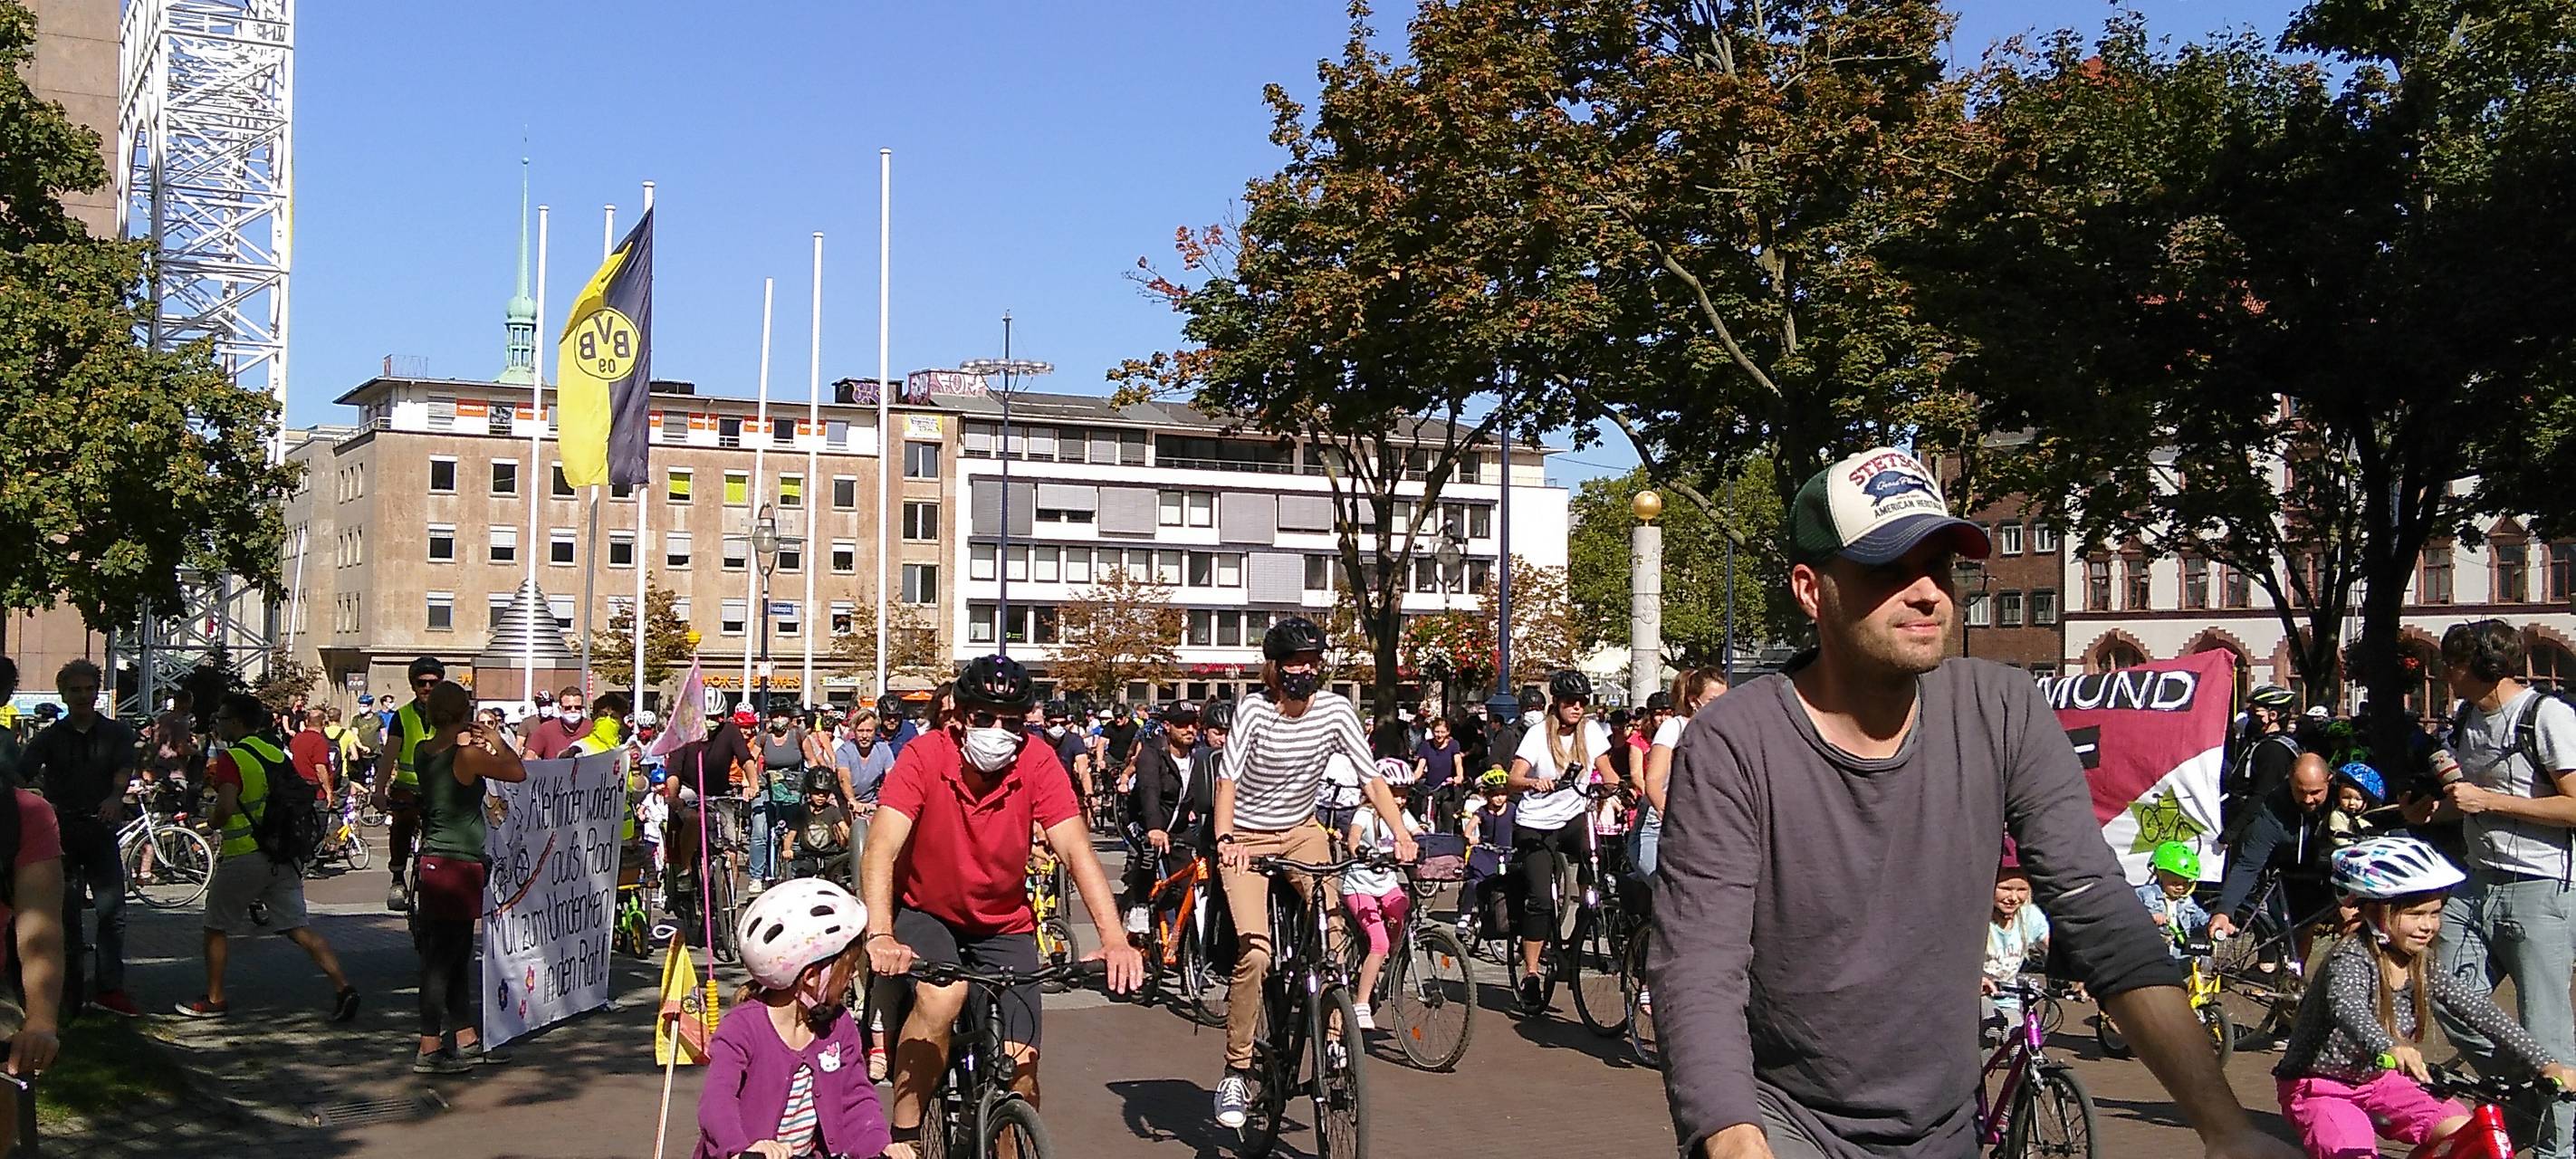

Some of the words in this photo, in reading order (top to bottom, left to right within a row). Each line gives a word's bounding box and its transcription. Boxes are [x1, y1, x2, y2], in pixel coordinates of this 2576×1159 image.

[1874, 500, 1915, 519] AMERICAN
[752, 674, 800, 688] BWLS
[525, 776, 551, 832] Alle
[551, 775, 585, 829] Kinder
[586, 771, 618, 823] wollen
[551, 830, 581, 886] aufs
[584, 824, 615, 877] Rad
[484, 906, 517, 960] Mut
[522, 909, 548, 952] zum
[547, 881, 609, 941] Umdenken
[543, 958, 554, 1004] in
[557, 947, 576, 997] den
